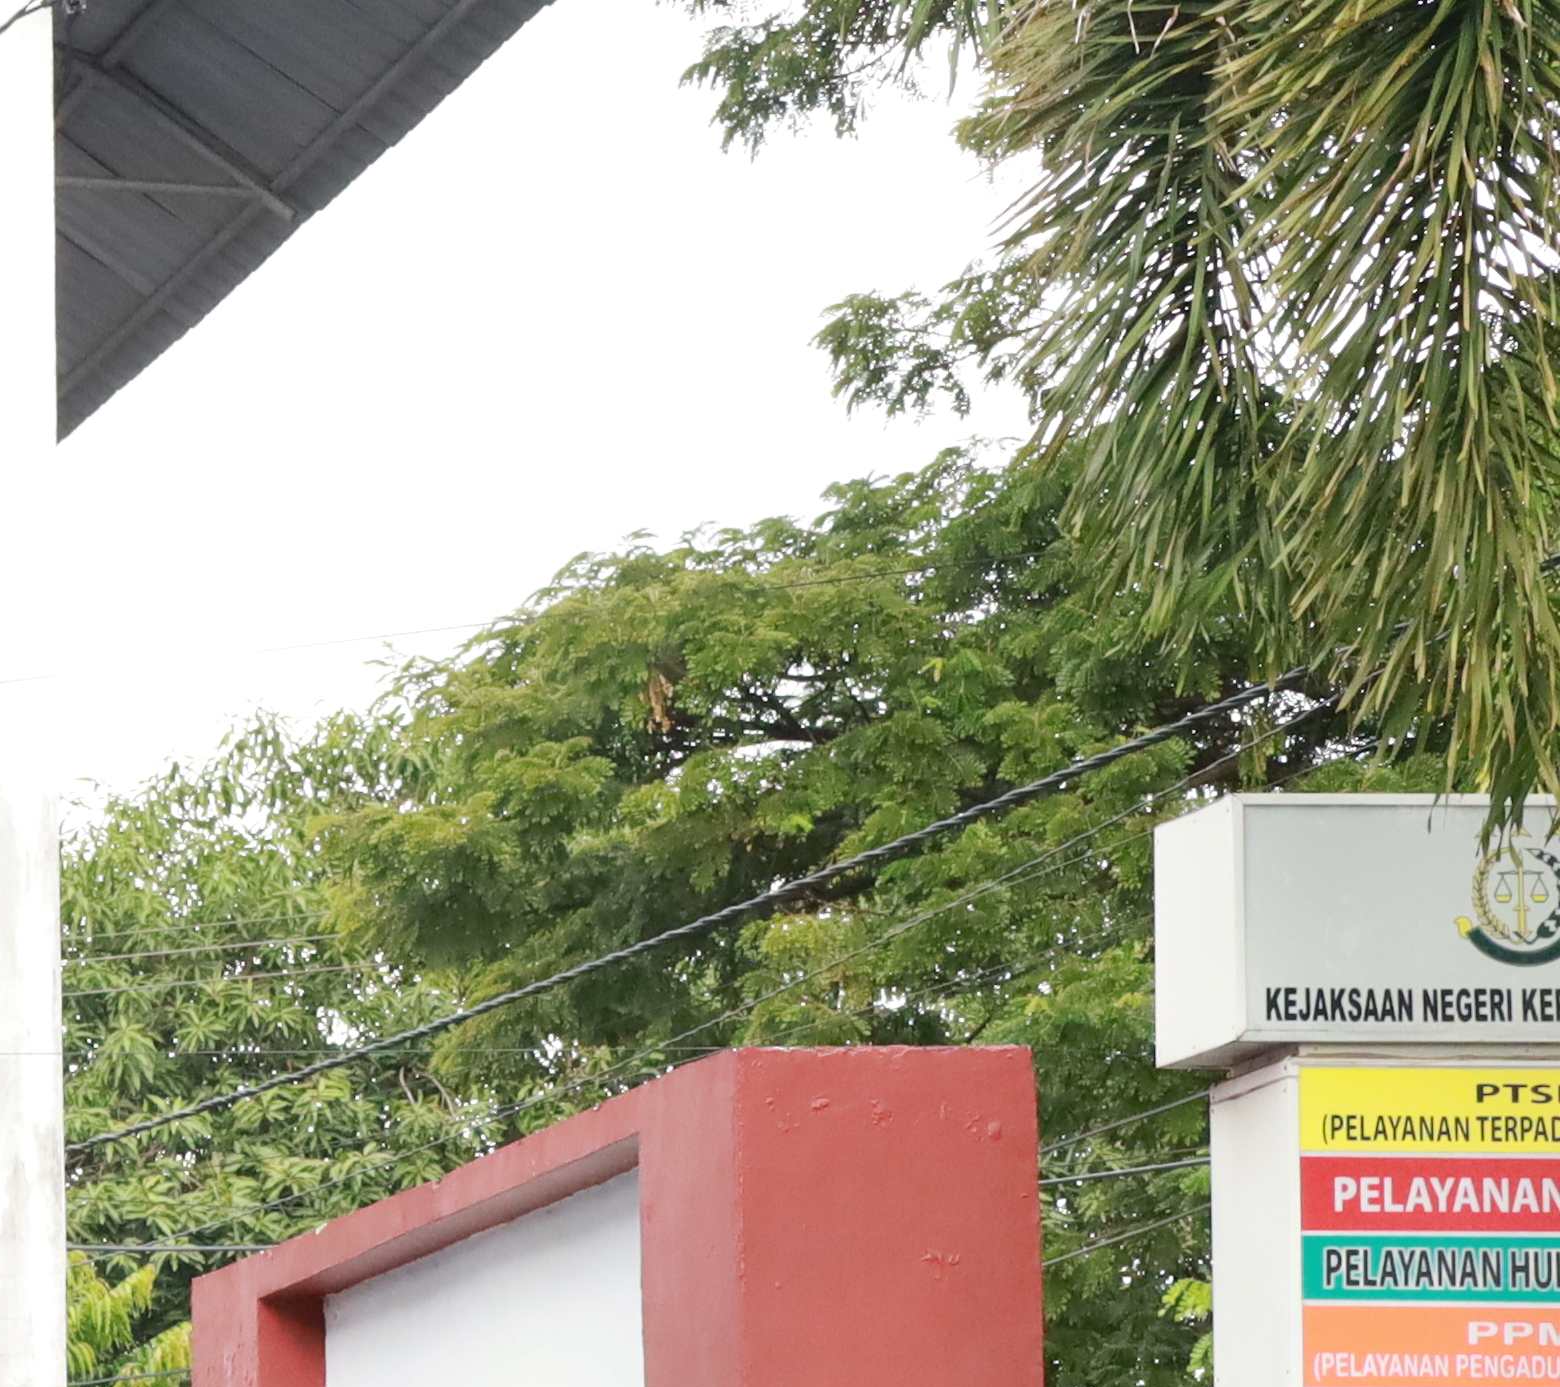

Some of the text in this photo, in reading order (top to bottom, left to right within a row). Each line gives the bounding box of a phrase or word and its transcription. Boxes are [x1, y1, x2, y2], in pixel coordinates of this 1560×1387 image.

[1265, 987, 1414, 1023] KEJAKSAAN
[1423, 988, 1513, 1022] NEGERI
[1476, 1083, 1560, 1104] PTS
[1322, 1114, 1470, 1145] (PELAYANAN
[1333, 1176, 1560, 1214] PELAYANAN
[1324, 1247, 1560, 1289] PELAYANAN HU
[1313, 1351, 1449, 1380] (PELAYANAN
